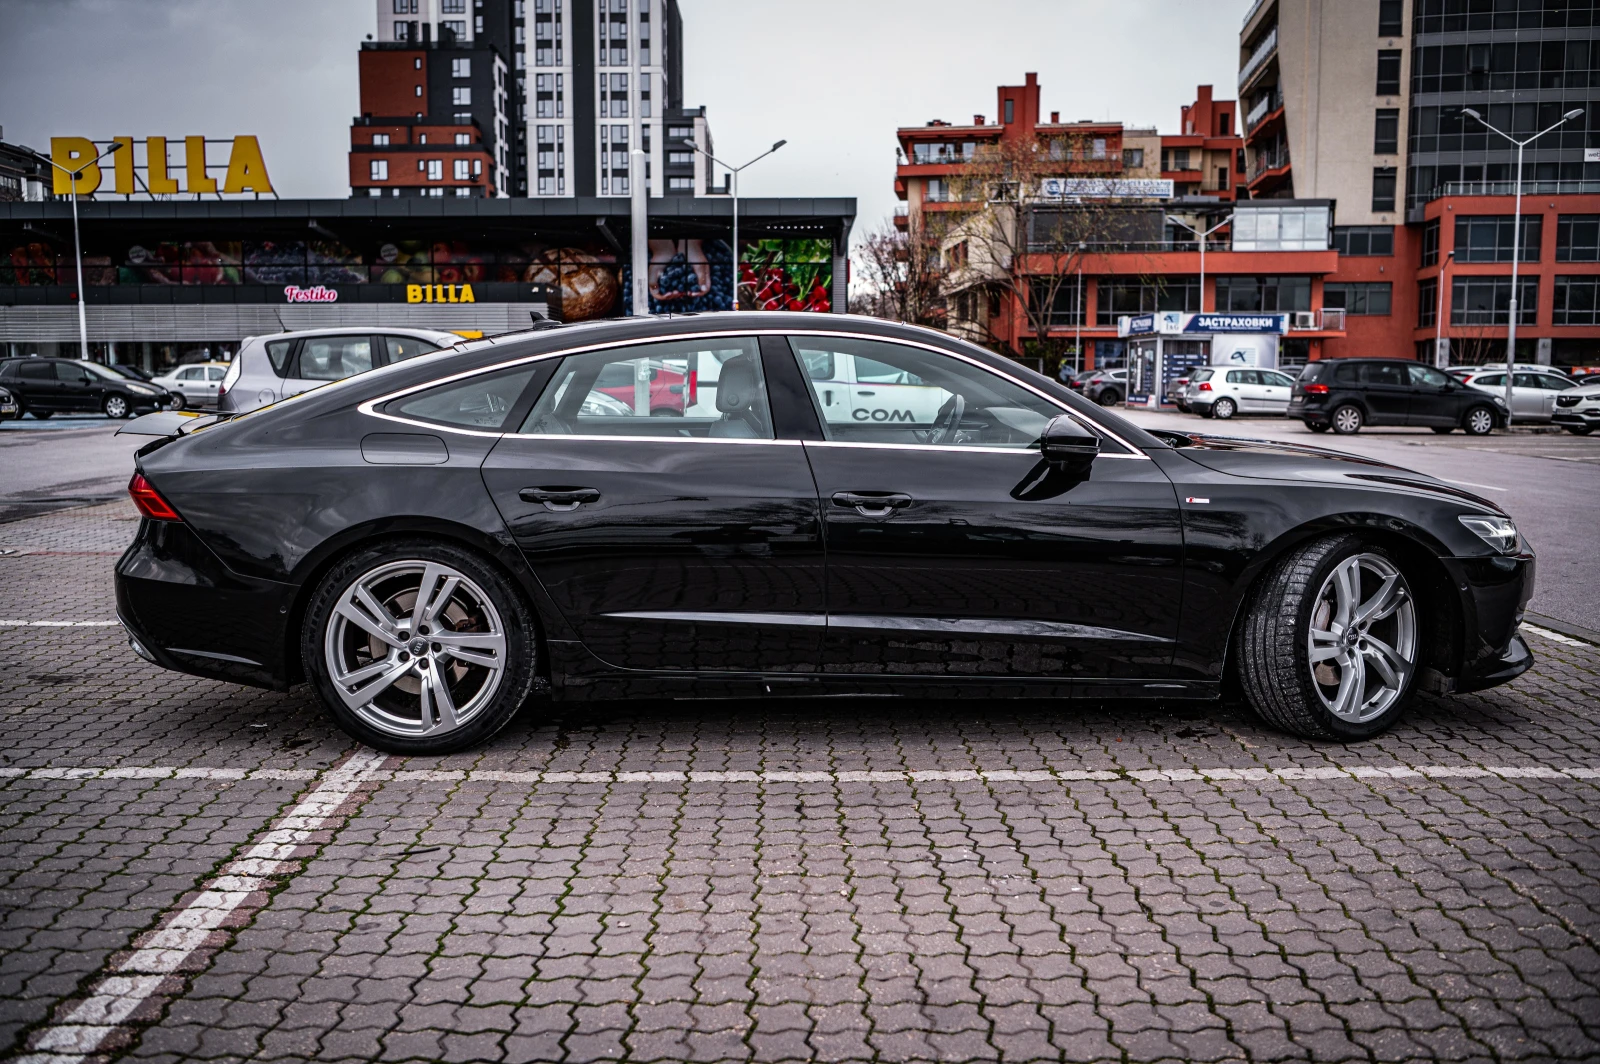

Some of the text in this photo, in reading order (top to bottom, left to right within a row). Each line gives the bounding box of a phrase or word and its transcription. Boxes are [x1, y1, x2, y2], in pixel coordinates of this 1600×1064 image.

[51, 136, 272, 194] BILLA
[284, 285, 338, 303] Festiko
[407, 284, 475, 303] BILLA
[1198, 317, 1273, 327] ЗАСТРАХОВКИ
[852, 409, 916, 422] COM
[309, 564, 356, 643] MINERVA
